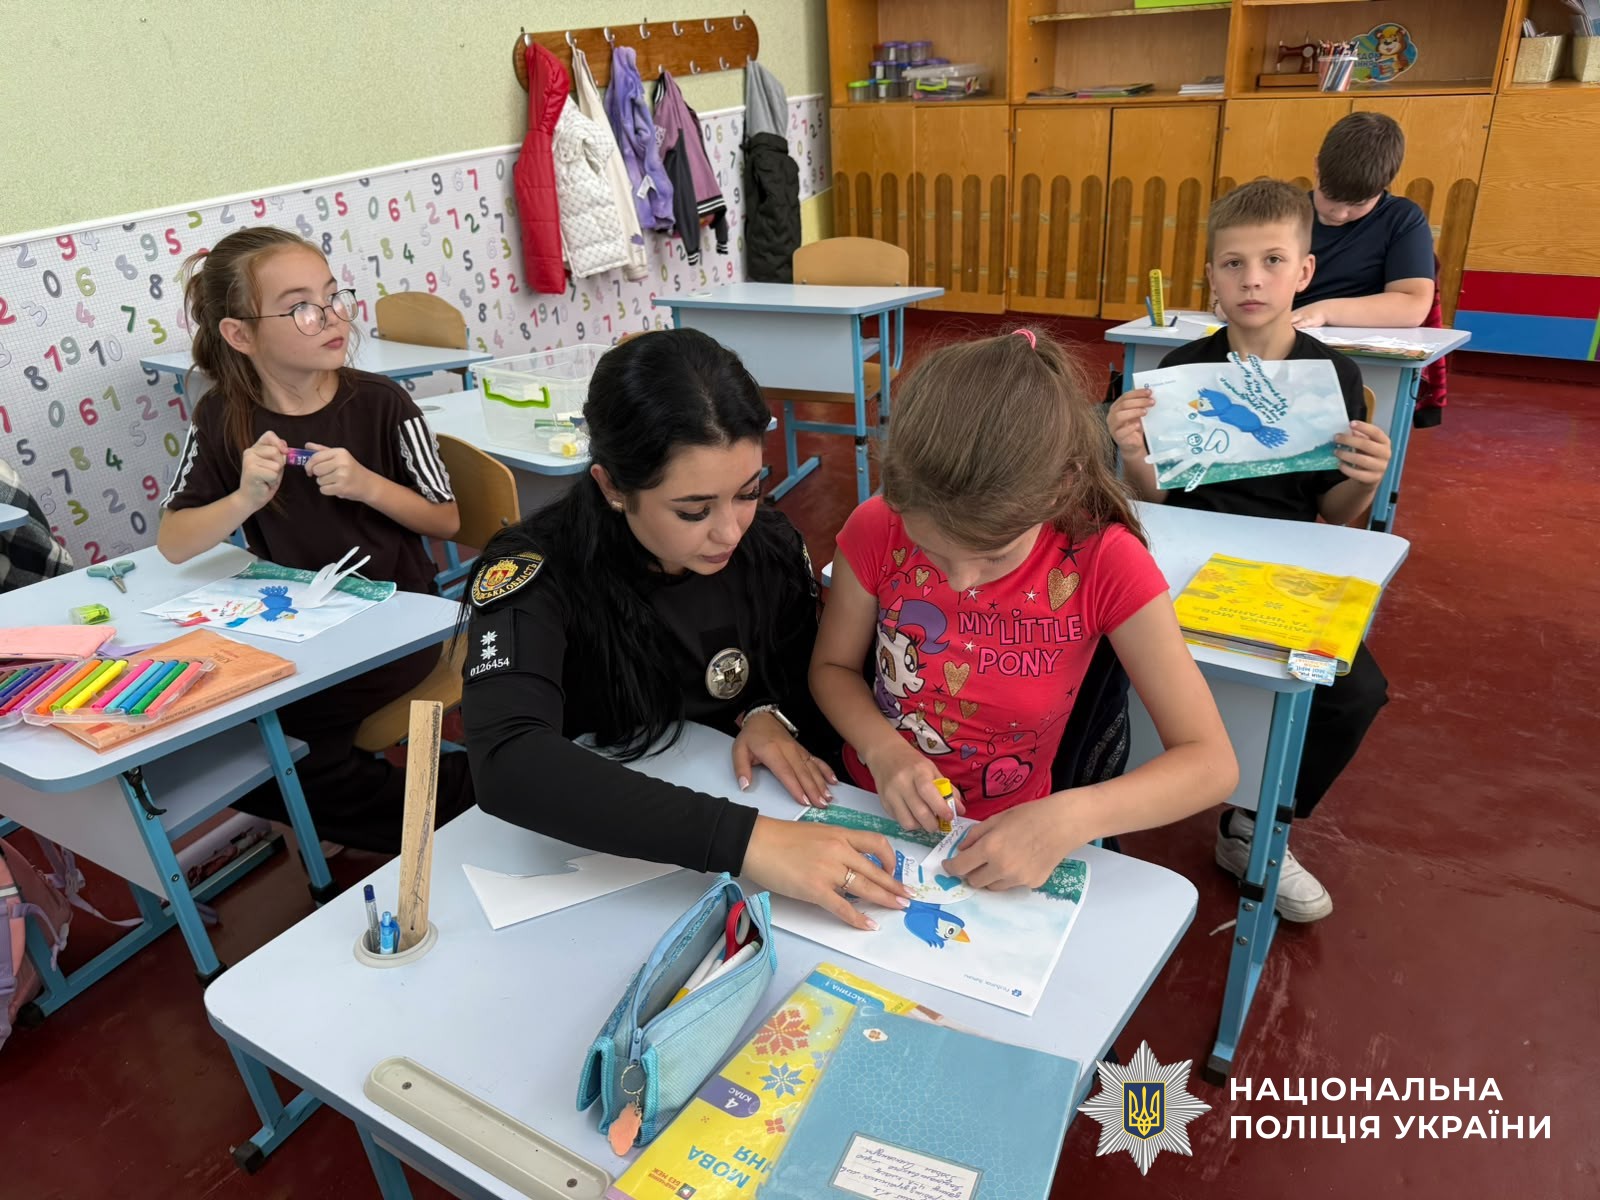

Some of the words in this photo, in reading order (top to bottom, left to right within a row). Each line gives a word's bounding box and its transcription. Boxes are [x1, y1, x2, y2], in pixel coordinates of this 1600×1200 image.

[810, 124, 817, 138] 2
[496, 159, 504, 180] 0
[730, 151, 736, 168] 7
[432, 173, 443, 195] 9
[335, 192, 348, 216] 5
[734, 188, 740, 203] 9
[315, 196, 329, 221] 9
[368, 197, 379, 219] 0
[389, 198, 400, 222] 6
[426, 202, 440, 224] 2
[479, 197, 488, 217] 5
[465, 213, 480, 233] 2
[495, 213, 504, 233] 7
[56, 235, 77, 261] 9
[140, 234, 158, 261] 9
[165, 228, 182, 255] 5
[322, 232, 332, 255] 8
[380, 238, 393, 259] 8
[442, 237, 453, 259] 0
[501, 238, 511, 259] 3
[404, 243, 414, 264] 4
[463, 250, 472, 271] 5
[677, 245, 686, 261] 2
[342, 264, 354, 286] 4
[368, 255, 380, 278] 7
[661, 264, 668, 282] 0
[712, 266, 720, 282] 2
[726, 261, 733, 278] 9
[43, 270, 61, 298] 0
[76, 267, 96, 296] 6
[150, 274, 162, 299] 8
[426, 272, 437, 293] 9
[475, 272, 485, 293] 9
[490, 268, 499, 288] 5
[507, 274, 519, 293] 2
[613, 280, 620, 297] 7
[674, 274, 681, 292] 5
[700, 270, 707, 286] 3
[581, 292, 590, 311] 3
[618, 302, 626, 320] 3
[632, 298, 642, 315] 2
[76, 302, 95, 328] 4
[121, 305, 135, 332] 7
[479, 303, 487, 323] 8
[643, 316, 649, 330] 0
[148, 318, 167, 345] 3
[520, 322, 531, 340] 8
[576, 322, 585, 340] 9
[24, 366, 48, 391] 8
[49, 401, 65, 427] 0
[79, 398, 98, 425] 6
[136, 395, 158, 420] 2
[17, 439, 36, 465] 5
[164, 433, 180, 457] 0
[70, 446, 91, 470] 8
[106, 448, 123, 471] 4
[52, 469, 72, 494] 7
[142, 475, 160, 500] 9
[103, 488, 125, 513] 2
[68, 500, 89, 525] 3
[130, 511, 146, 534] 0
[84, 541, 108, 564] 2
[958, 612, 1000, 635] MY
[470, 657, 510, 677] 0126454
[977, 648, 1063, 677] PONY
[832, 984, 866, 1003] ЧАСТИНА
[724, 1098, 739, 1109] 4
[728, 1087, 752, 1103] КЛАС
[688, 1145, 751, 1188] МОВА
[668, 1176, 681, 1186] БЕЗ
